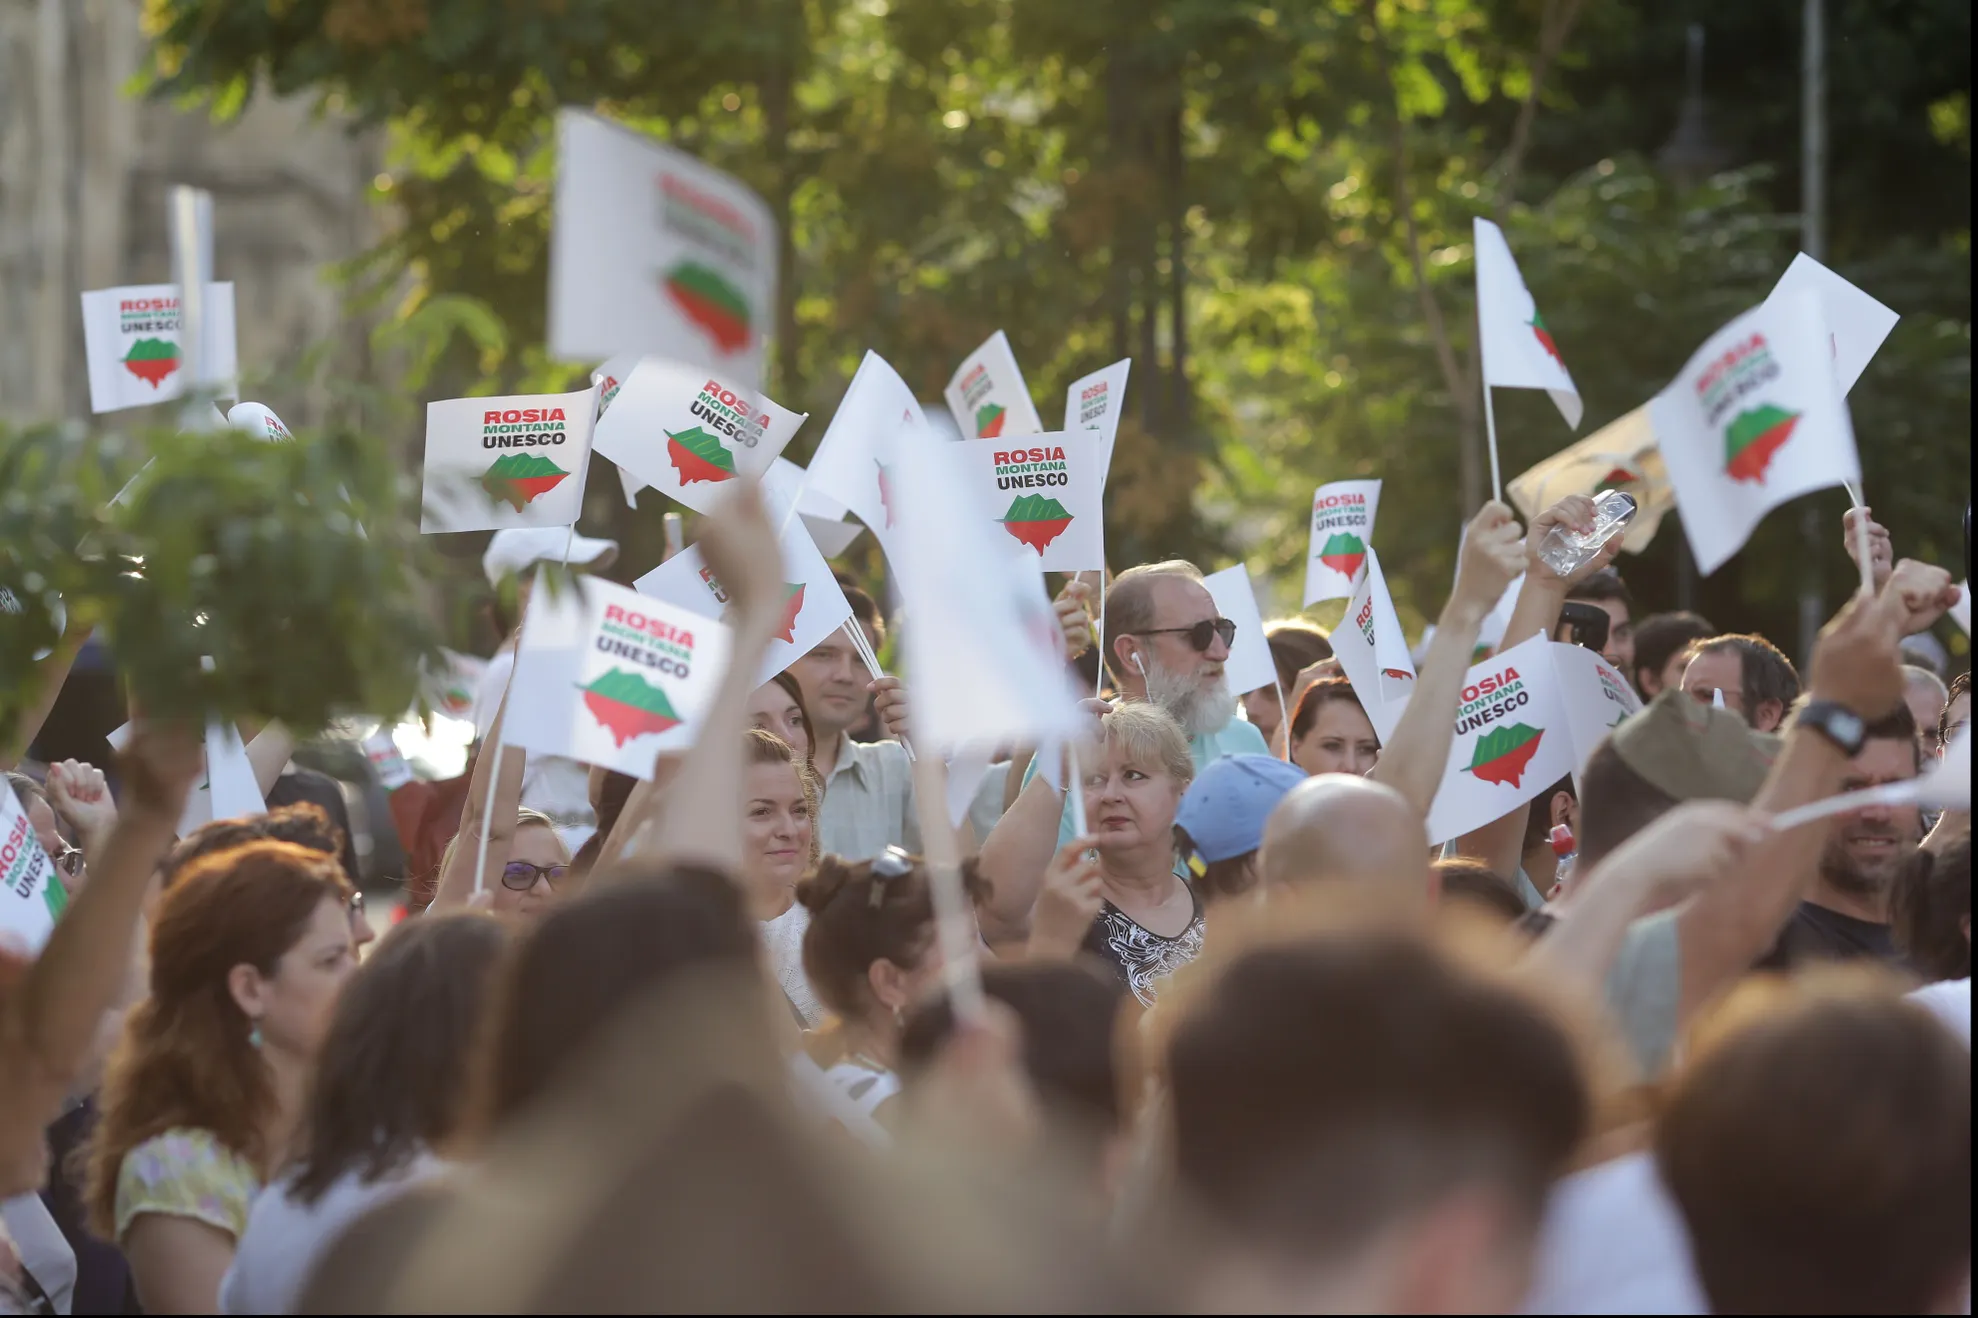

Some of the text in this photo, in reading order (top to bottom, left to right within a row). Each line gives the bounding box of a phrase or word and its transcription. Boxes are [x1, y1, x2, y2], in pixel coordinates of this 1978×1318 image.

[484, 408, 566, 424] ROSIA
[703, 380, 771, 429] ROSIA
[483, 422, 565, 434] MONTANA
[689, 400, 759, 449] UNESCO
[483, 433, 566, 449] UNESCO
[993, 447, 1066, 466] ROSIA
[995, 461, 1067, 475] MONTANA
[997, 472, 1069, 491] UNESCO
[605, 603, 694, 649] ROSIA
[597, 635, 689, 679] UNESCO
[1456, 667, 1521, 706] OSIA
[1456, 691, 1529, 735] UNESCO
